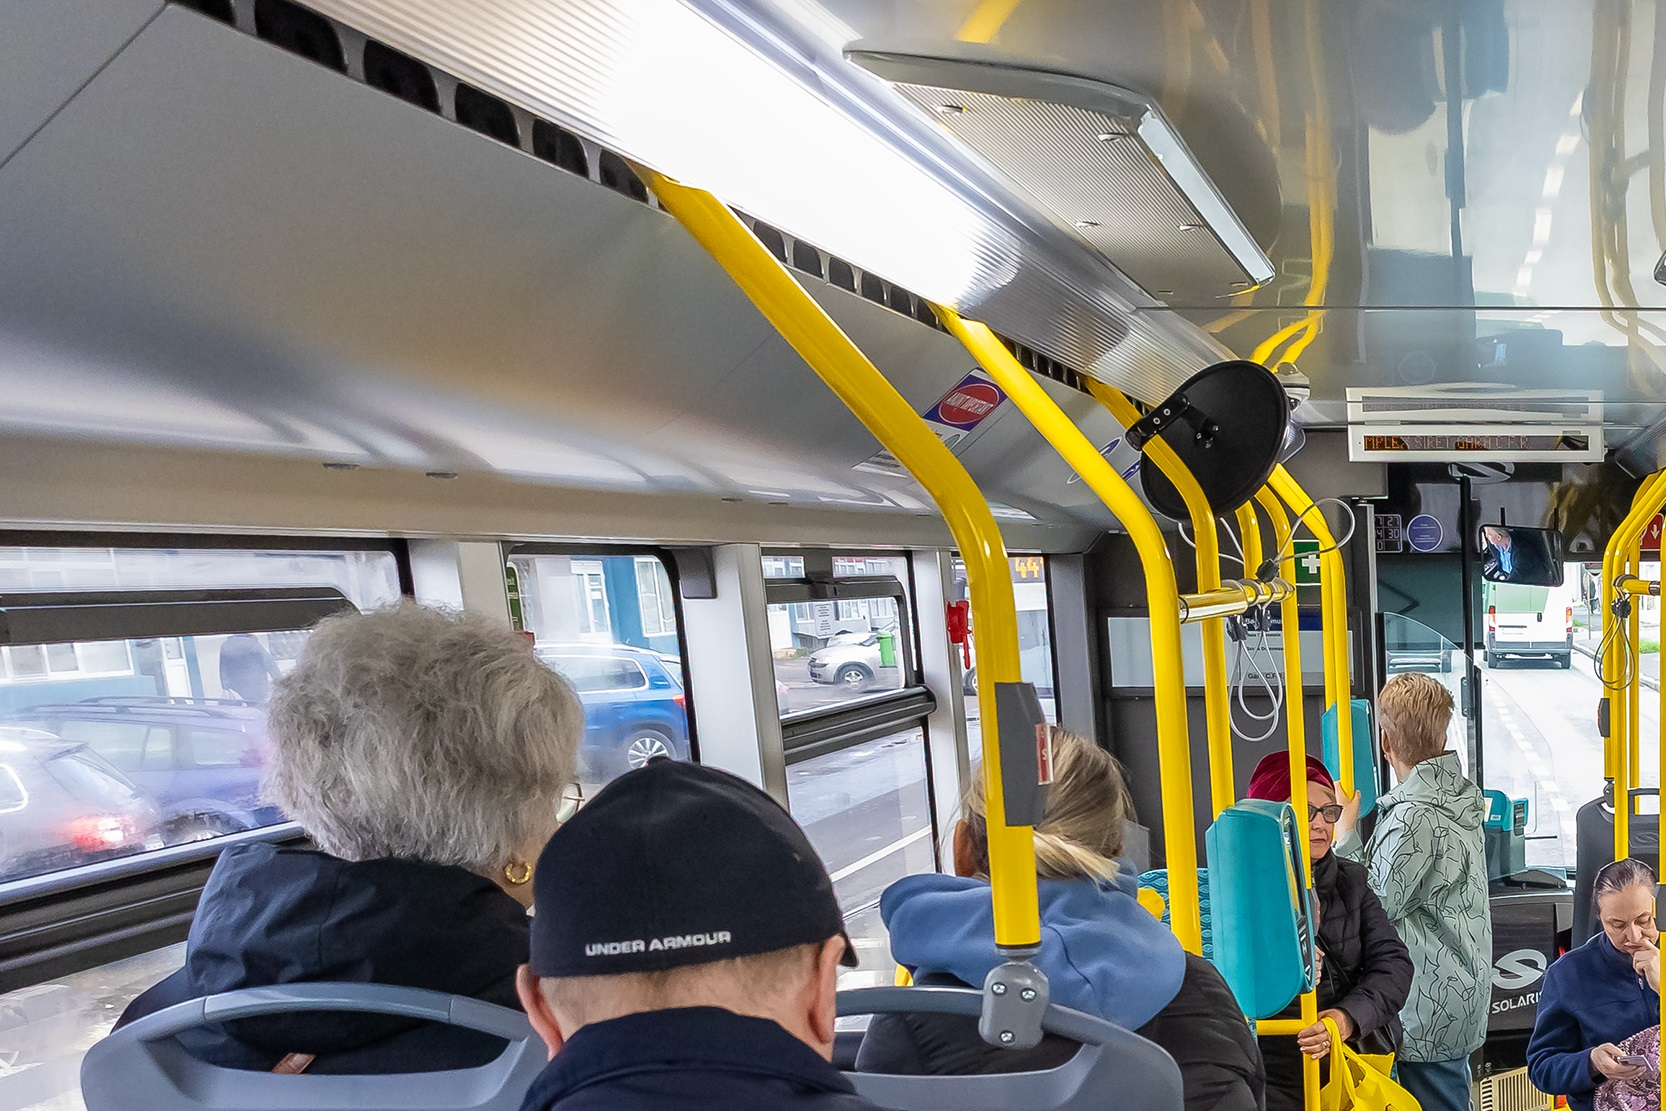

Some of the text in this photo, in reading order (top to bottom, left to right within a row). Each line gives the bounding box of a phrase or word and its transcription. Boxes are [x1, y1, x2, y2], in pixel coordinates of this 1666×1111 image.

[1388, 528, 1400, 539] 30
[585, 930, 732, 957] UNDER ARMOUR
[1491, 990, 1543, 1014] SOLARI
